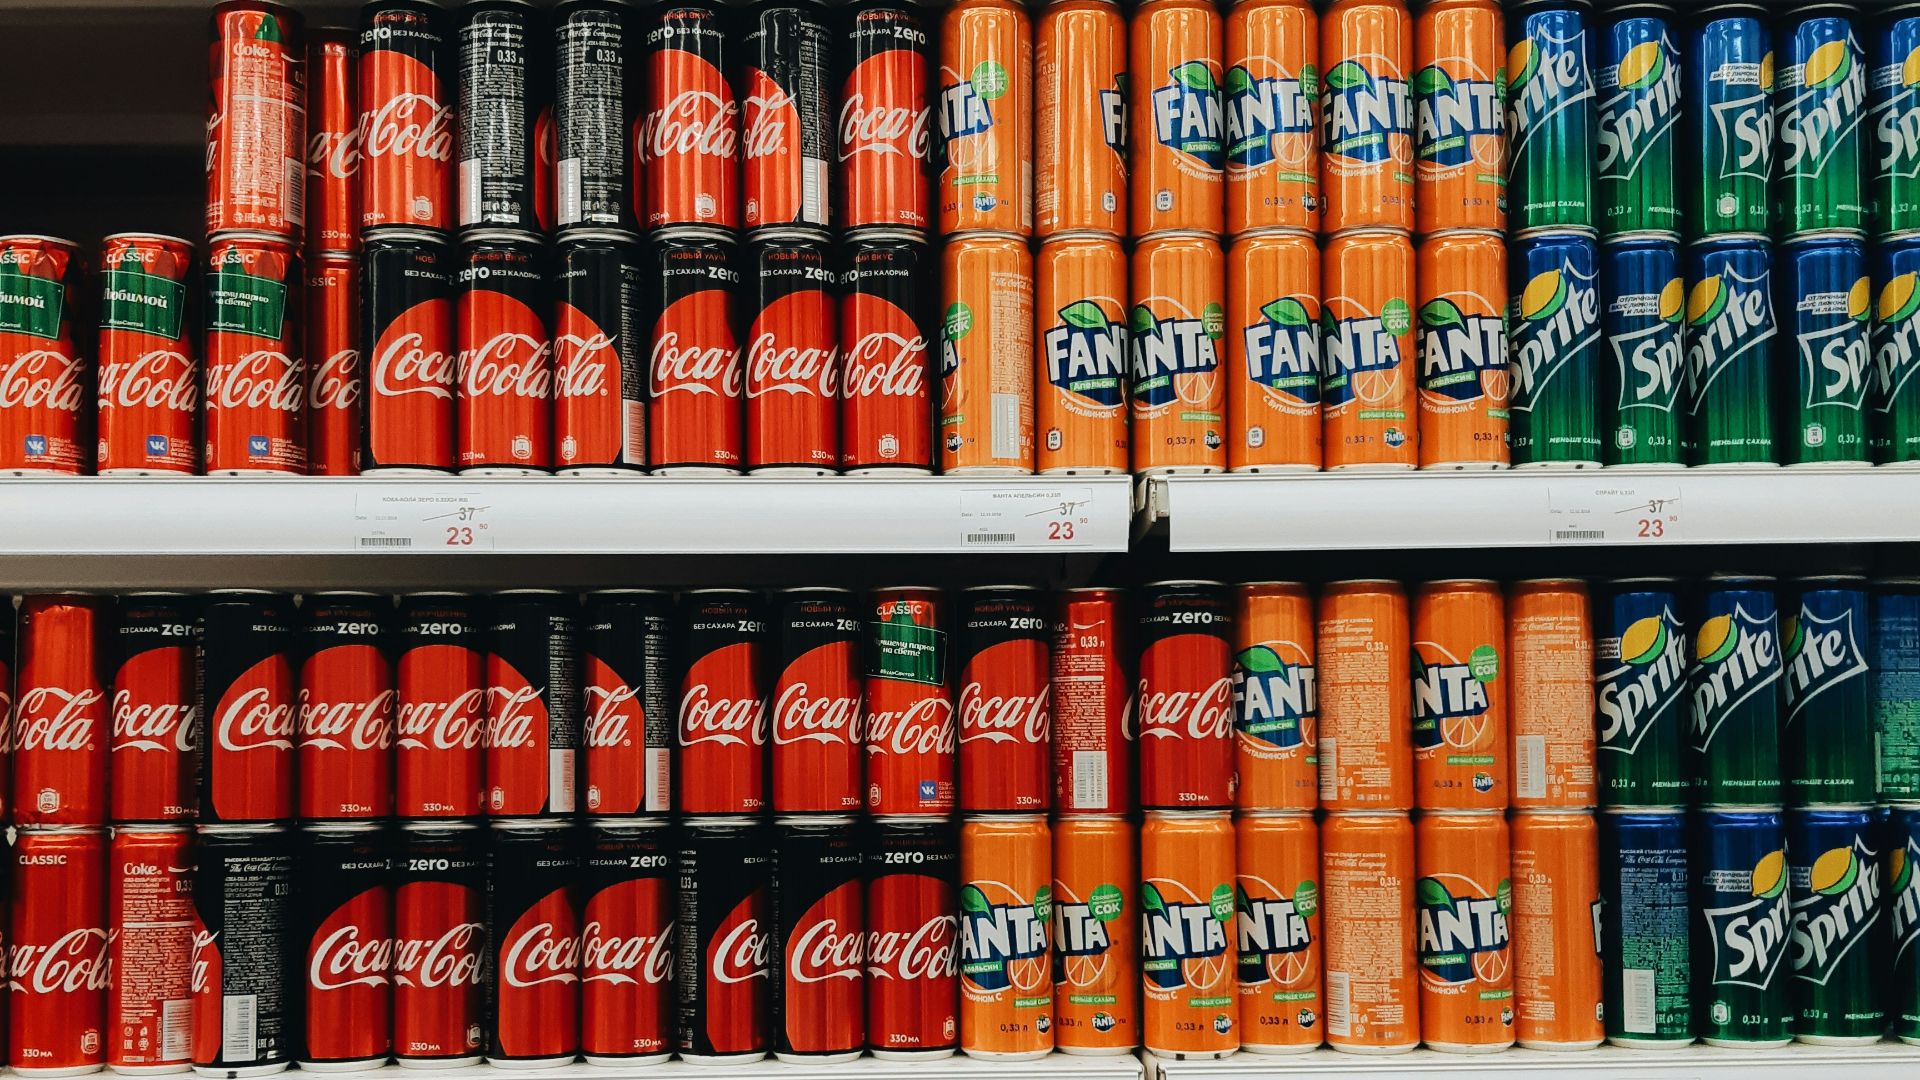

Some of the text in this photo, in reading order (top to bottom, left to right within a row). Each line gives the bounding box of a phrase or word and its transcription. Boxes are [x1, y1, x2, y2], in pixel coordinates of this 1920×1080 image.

[361, 26, 391, 45] zero
[647, 26, 675, 46] zero
[893, 25, 926, 45] zero
[232, 42, 270, 58] Coke
[497, 50, 517, 63] 0,33
[596, 50, 616, 63] 0,33
[899, 210, 915, 220] 330
[321, 230, 339, 239] 330
[106, 250, 155, 265] CLASSIC
[210, 251, 256, 267] CLASSIC
[405, 269, 420, 277] БЕЗ
[460, 265, 507, 283] zero БЕЗ
[676, 266, 739, 284] САХАРА zero
[773, 266, 835, 284] САХАРА zero
[860, 269, 909, 278] БЕЗ КАЛОРИЙ
[104, 288, 168, 309] Любимой
[947, 319, 969, 335] СОК
[1066, 402, 1110, 418] ВИТАМИНОМ
[1167, 437, 1187, 447] 0,33
[1474, 432, 1492, 442] 0,33
[1647, 436, 1666, 447] 0,33
[1837, 433, 1855, 444] 0,33
[714, 450, 730, 460] 330
[811, 450, 827, 460] 330
[1060, 502, 1075, 516] 37
[1648, 500, 1664, 513] 37
[459, 507, 475, 521] 37
[1048, 521, 1074, 540] 23
[1638, 519, 1664, 538] 23
[447, 526, 474, 545] 23
[877, 604, 922, 616] CLASSIC
[979, 616, 1043, 630] САХАРА zero
[1172, 611, 1213, 625] zero
[130, 625, 158, 634] САХАРА
[337, 621, 379, 636] zero
[420, 621, 462, 636] zero
[694, 623, 706, 631] БЕЗ
[792, 620, 834, 629] БЕЗ САХАРА
[1080, 635, 1098, 648] 0,33
[1475, 665, 1497, 676] СОК
[1611, 777, 1628, 789] 0,33
[743, 798, 758, 808] 330
[841, 797, 856, 807] 330
[1016, 796, 1033, 806] 330
[1179, 792, 1197, 802] 330
[164, 806, 182, 815] 330
[341, 803, 359, 813] 330
[424, 802, 441, 812] 330
[19, 854, 67, 865] CLASSIC
[600, 854, 668, 869] САХАРА zero
[884, 850, 924, 864] zero
[123, 862, 158, 876] Coke
[342, 862, 357, 870] БЕЗ
[409, 857, 449, 871] zero
[1380, 876, 1396, 887] 0,33
[1528, 874, 1546, 885] 0,33
[1095, 901, 1121, 916] СОК
[1215, 901, 1234, 915] СОК
[961, 906, 1047, 960] ANTA
[1092, 1015, 1116, 1027] FANTA
[1260, 1015, 1280, 1026] 0,33
[1465, 1015, 1485, 1025] 0,33
[1742, 1014, 1761, 1025] 0,33
[1000, 1022, 1020, 1033] 0,33
[1176, 1021, 1195, 1031] 0,33
[633, 1038, 651, 1048] 330
[890, 1033, 907, 1043] 330
[23, 1047, 40, 1057] 330
[410, 1041, 427, 1051] 330
